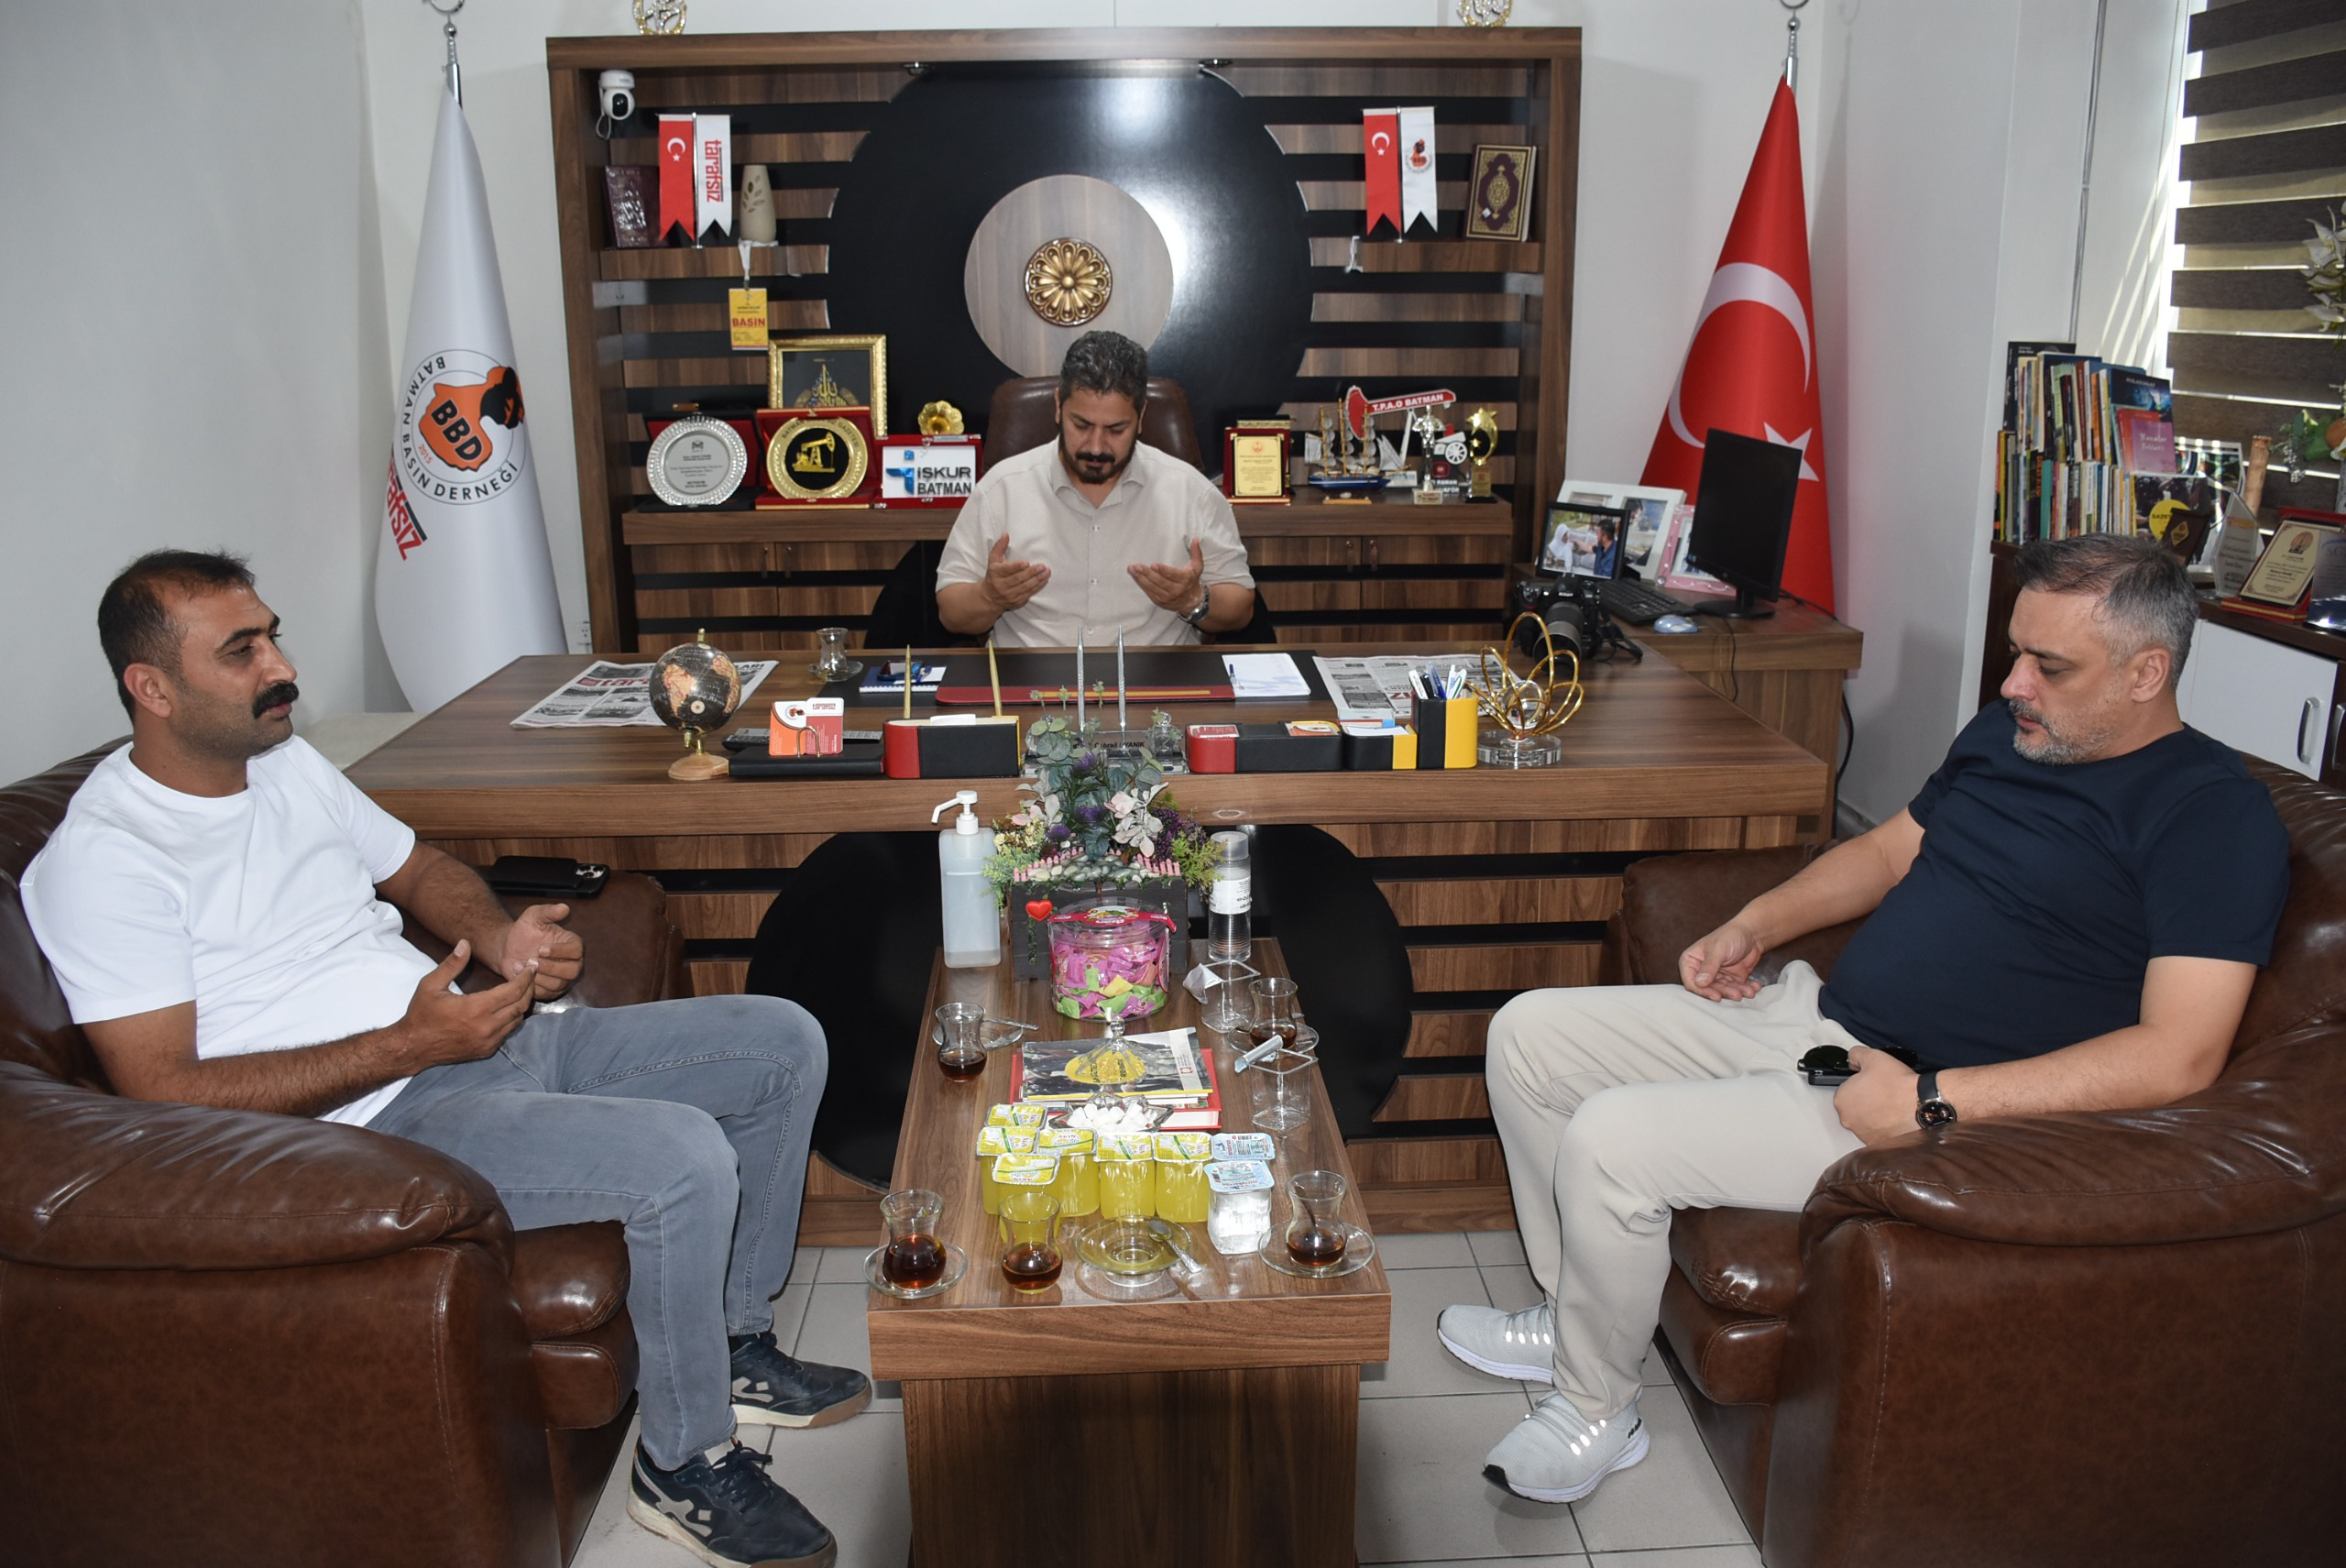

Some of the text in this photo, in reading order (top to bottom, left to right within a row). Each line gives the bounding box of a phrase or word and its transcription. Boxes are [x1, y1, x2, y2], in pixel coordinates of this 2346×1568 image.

[732, 317, 765, 326] BASIN
[1405, 394, 1444, 406] BATMAN
[402, 356, 518, 499] BATMAN BASIN DERNEĞİ
[431, 399, 482, 461] BBD
[418, 444, 433, 465] 2015
[917, 482, 972, 495] BATMAN
